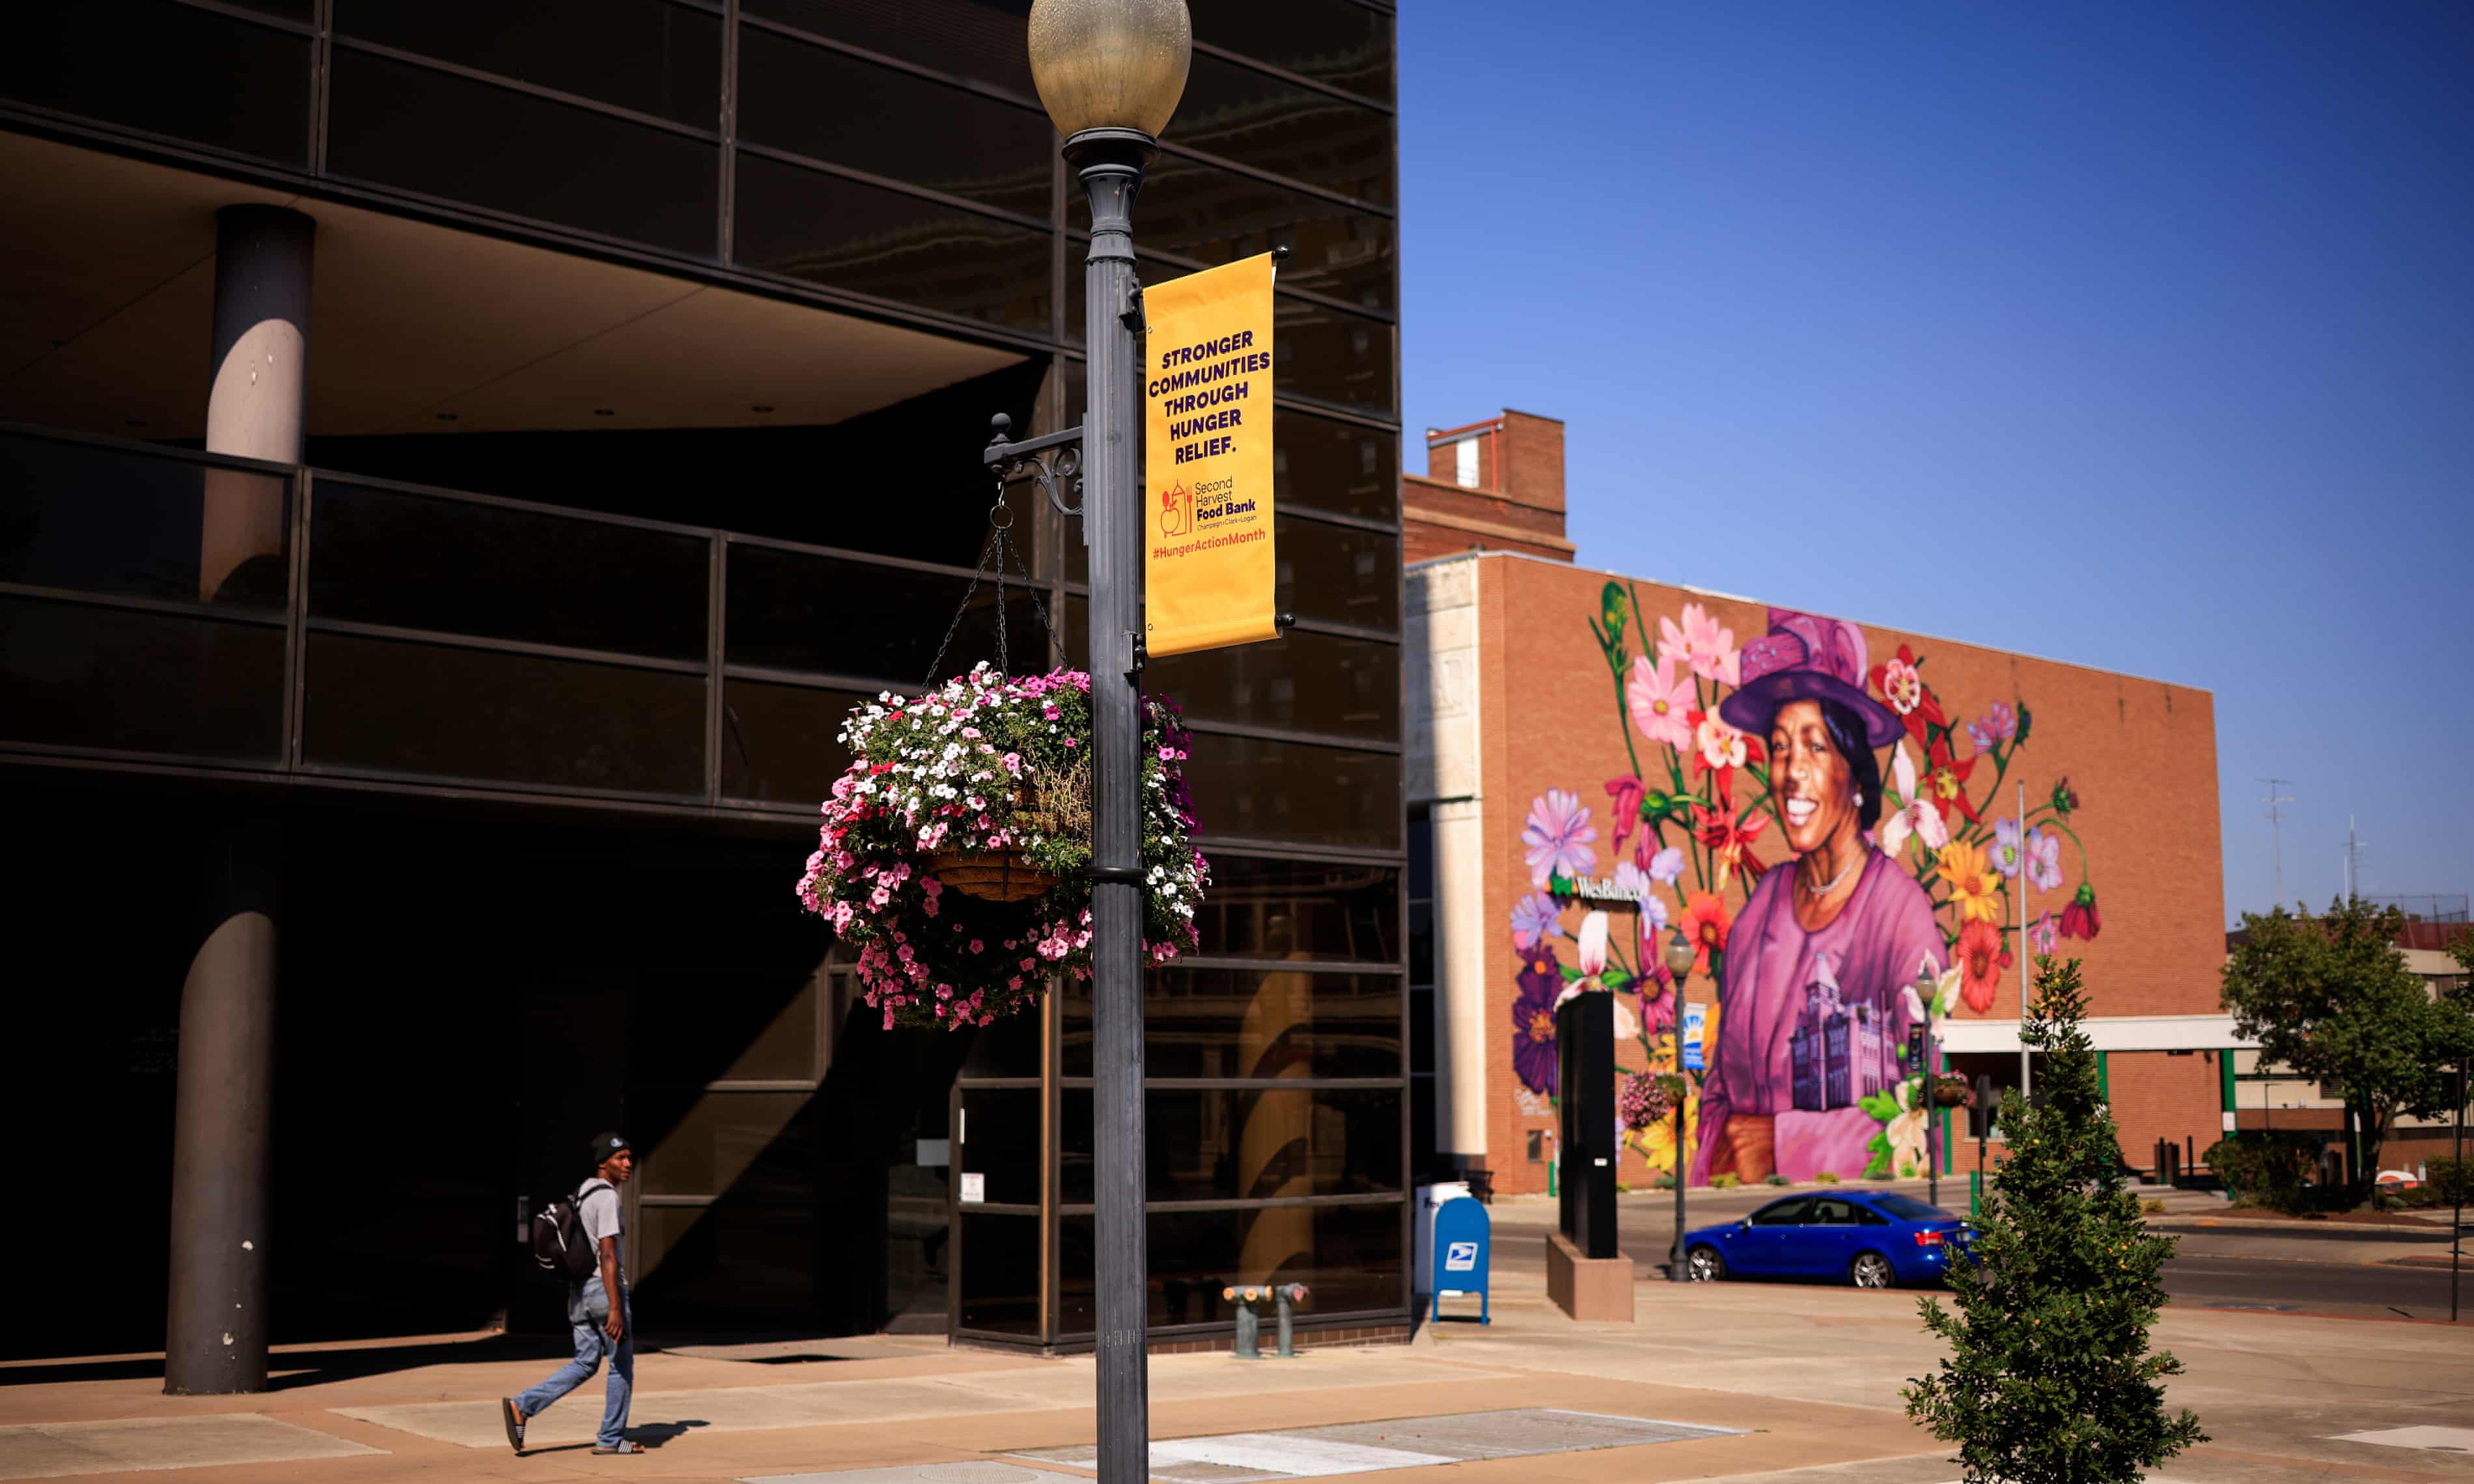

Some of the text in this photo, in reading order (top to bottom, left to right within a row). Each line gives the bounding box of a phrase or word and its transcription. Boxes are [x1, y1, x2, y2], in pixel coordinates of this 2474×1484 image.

[1162, 331, 1253, 369] STRONGER
[1149, 351, 1270, 397] COMMUNITIES
[1165, 381, 1248, 417] THROUGH
[1170, 409, 1242, 441] HUNGER
[1175, 435, 1236, 465] RELIEF.
[1195, 474, 1232, 495] Second
[1196, 490, 1232, 508] Harvest
[1197, 499, 1256, 521] Food Bank
[1153, 529, 1266, 560] #HungerActionMonth
[1577, 876, 1641, 901] WesBanco
